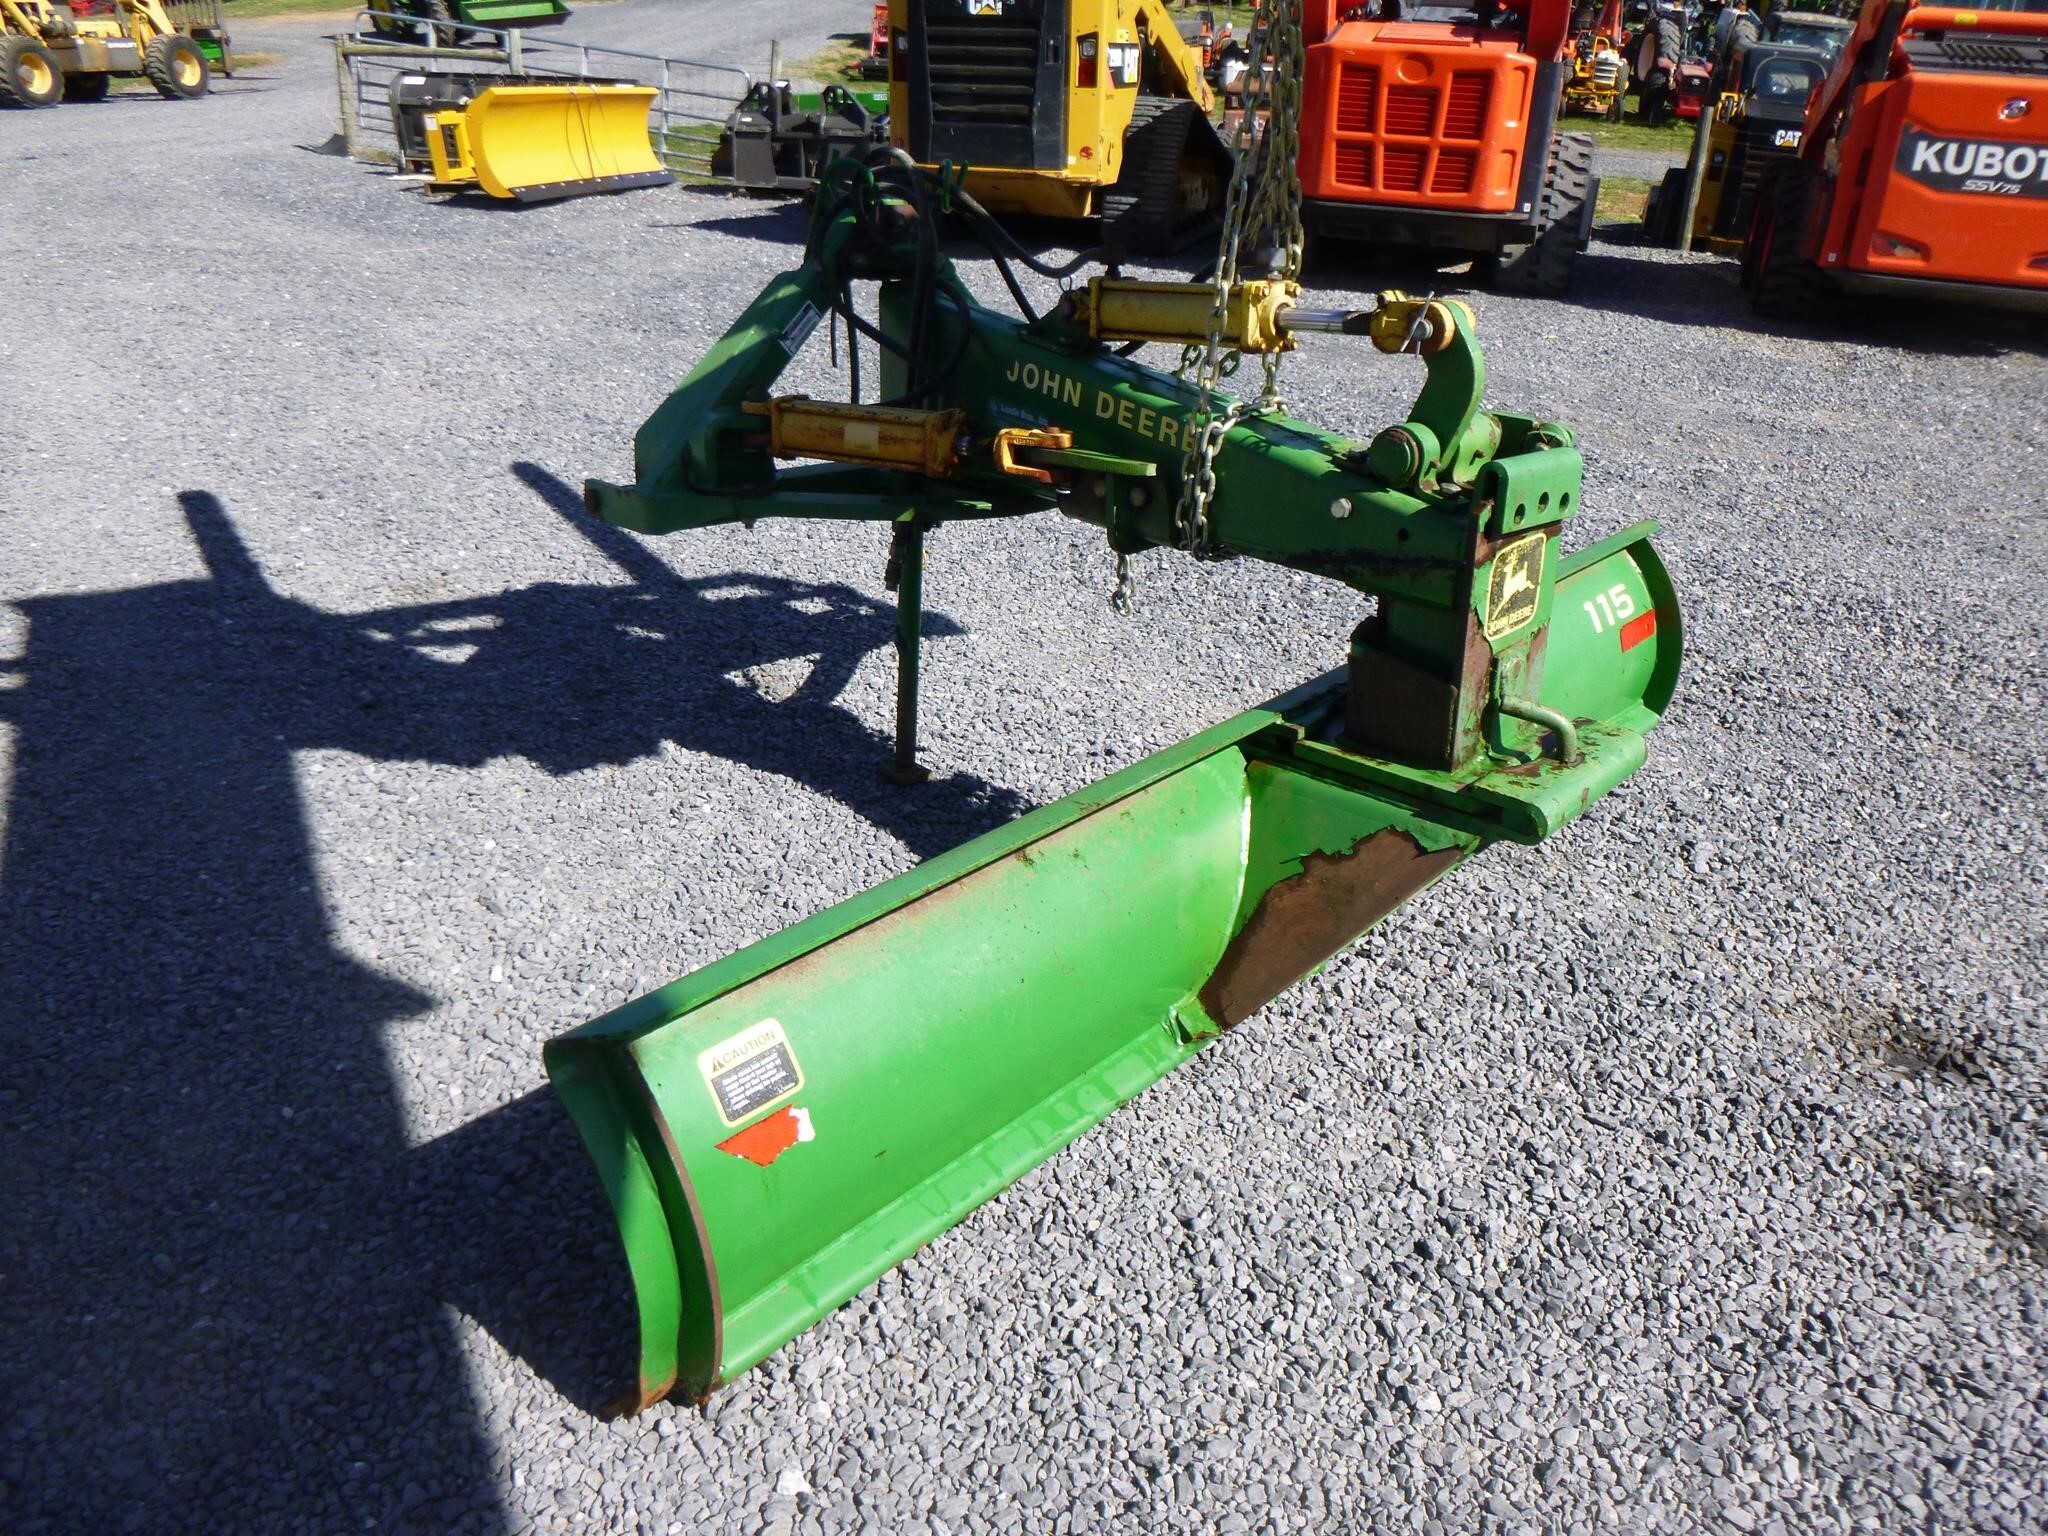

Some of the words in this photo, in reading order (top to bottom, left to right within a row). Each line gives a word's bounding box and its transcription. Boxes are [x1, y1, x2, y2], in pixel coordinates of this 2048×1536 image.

[1775, 129, 1802, 148] CAT
[1961, 179, 2022, 194] SSV75
[1006, 360, 1082, 408] JOHN
[1488, 616, 1509, 635] JOHN
[1509, 604, 1534, 625] DEERE
[1583, 583, 1635, 634] 115
[722, 1031, 776, 1064] CAUTION
